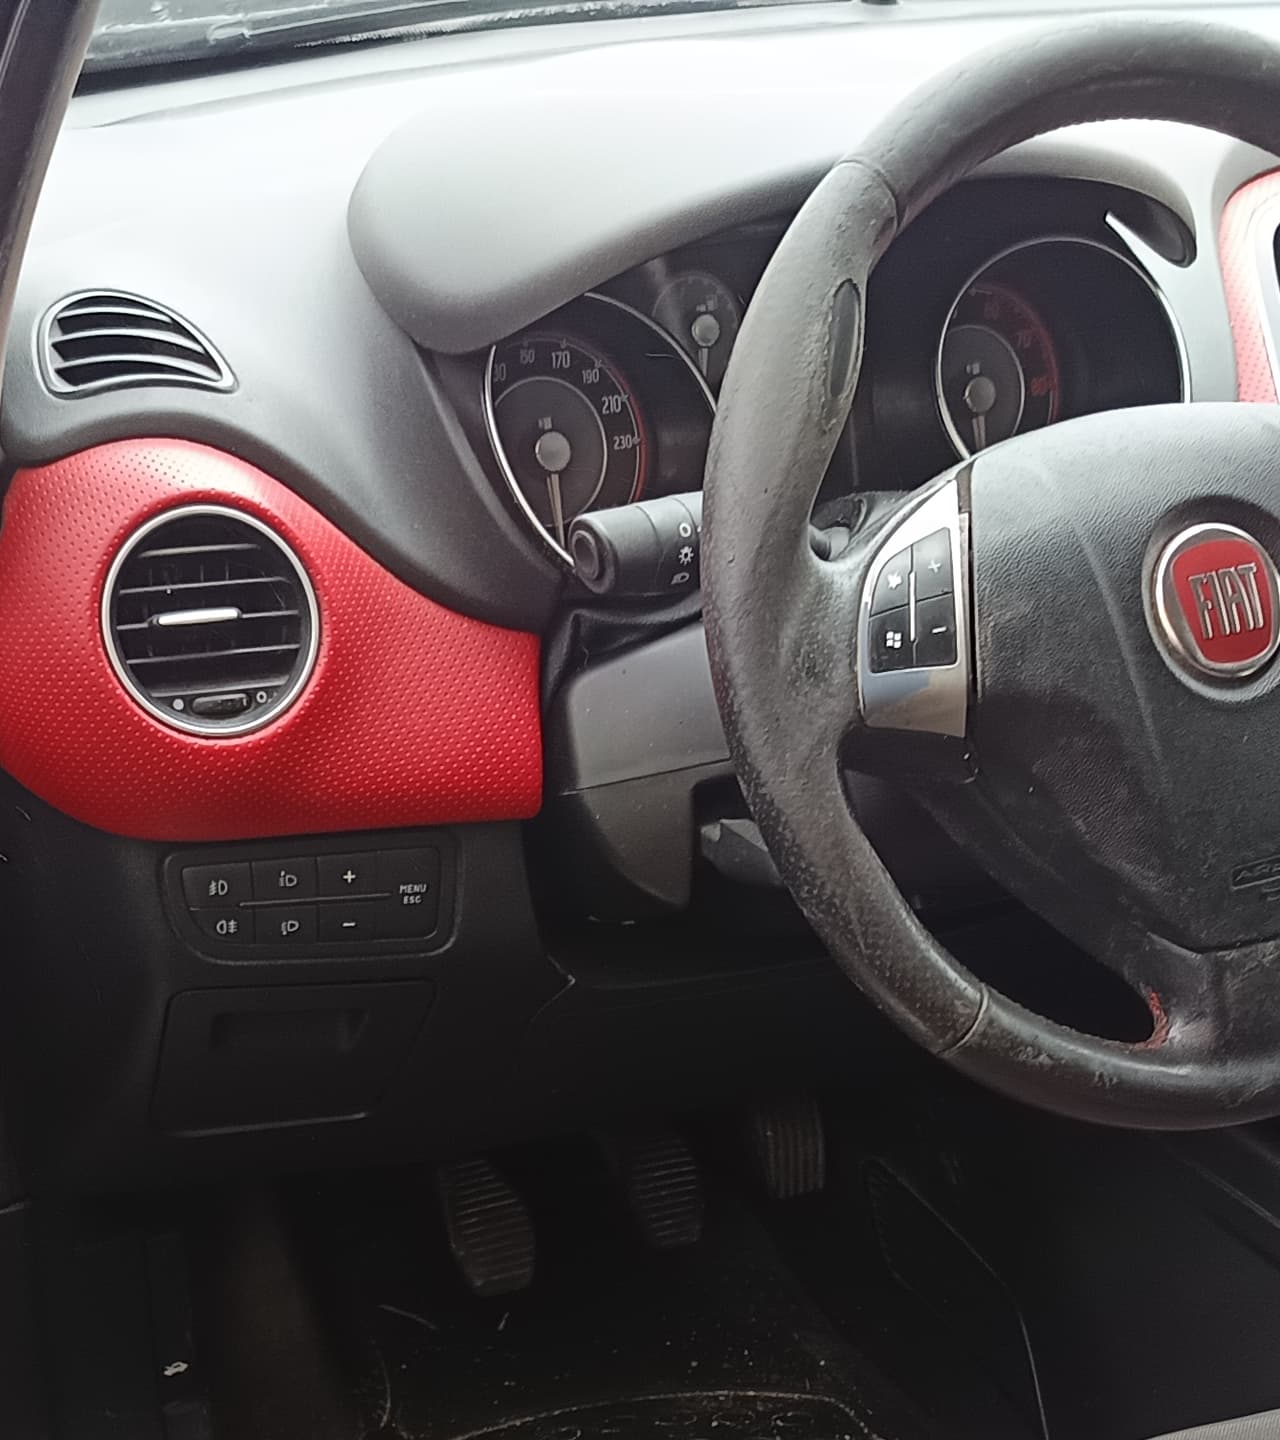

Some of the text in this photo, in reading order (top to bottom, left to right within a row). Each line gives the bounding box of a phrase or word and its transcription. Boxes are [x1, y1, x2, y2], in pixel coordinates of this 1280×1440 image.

[552, 350, 570, 369] 170
[582, 369, 600, 384] 190
[601, 394, 621, 415] 210
[613, 434, 632, 450] 230
[1187, 561, 1265, 640] FIAT
[399, 883, 427, 894] MENU
[403, 895, 422, 905] ESC
